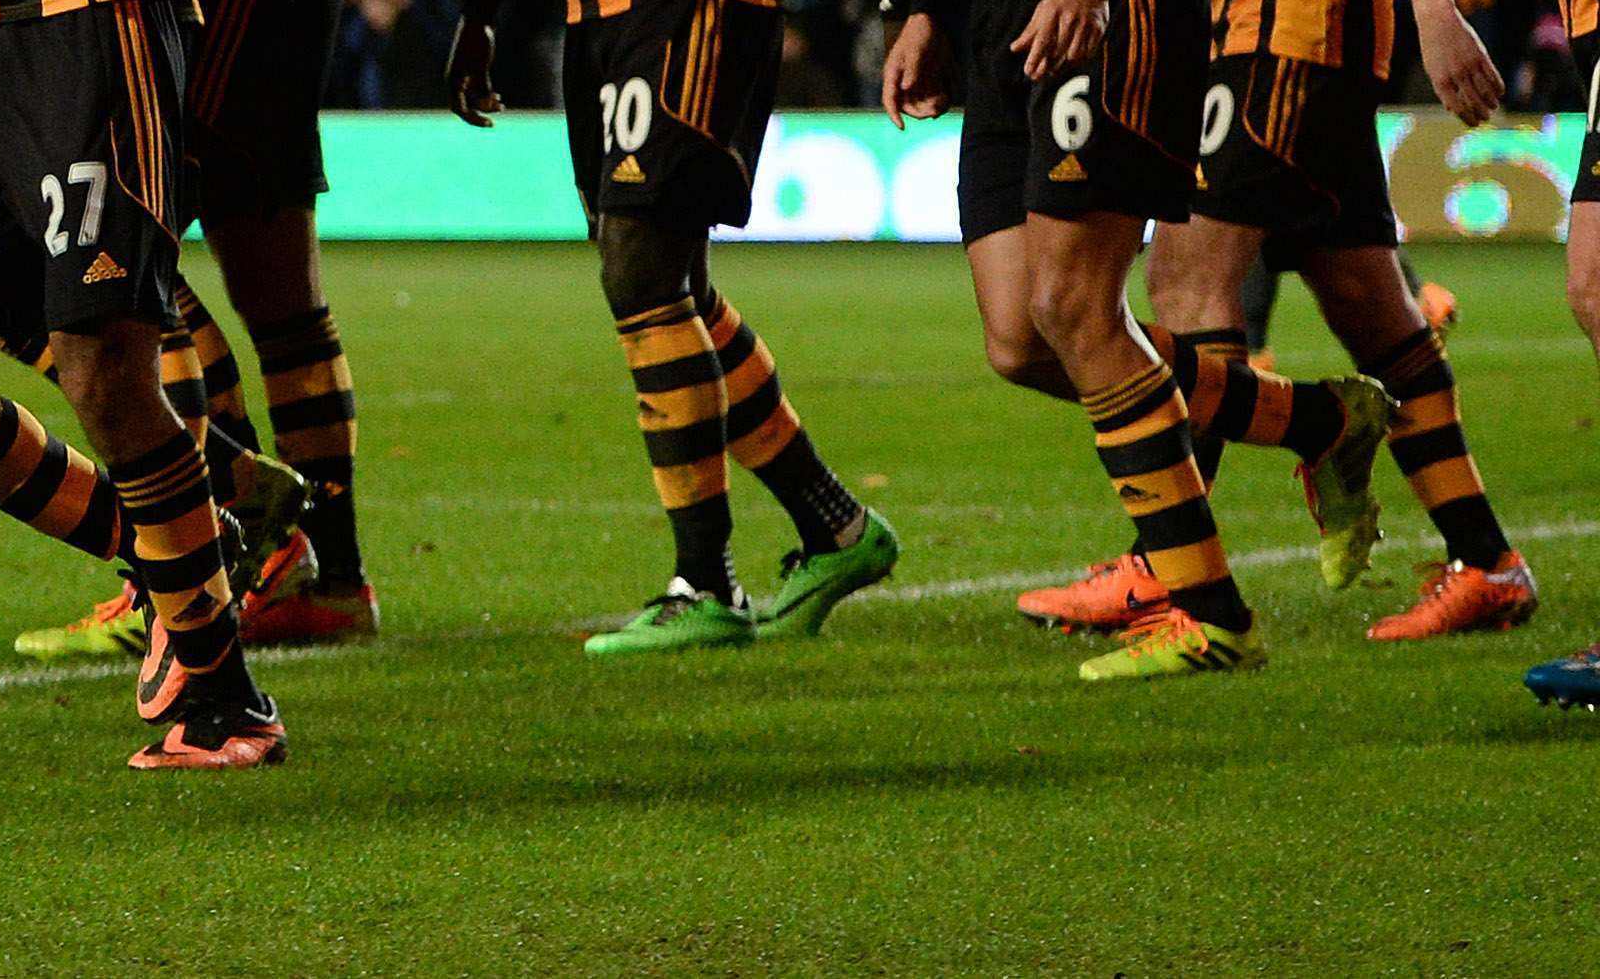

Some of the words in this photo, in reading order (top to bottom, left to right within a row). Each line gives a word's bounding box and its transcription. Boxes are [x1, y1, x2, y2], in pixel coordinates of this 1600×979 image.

[1051, 74, 1094, 152] 6
[1199, 83, 1235, 156] 0
[40, 160, 107, 258] 27
